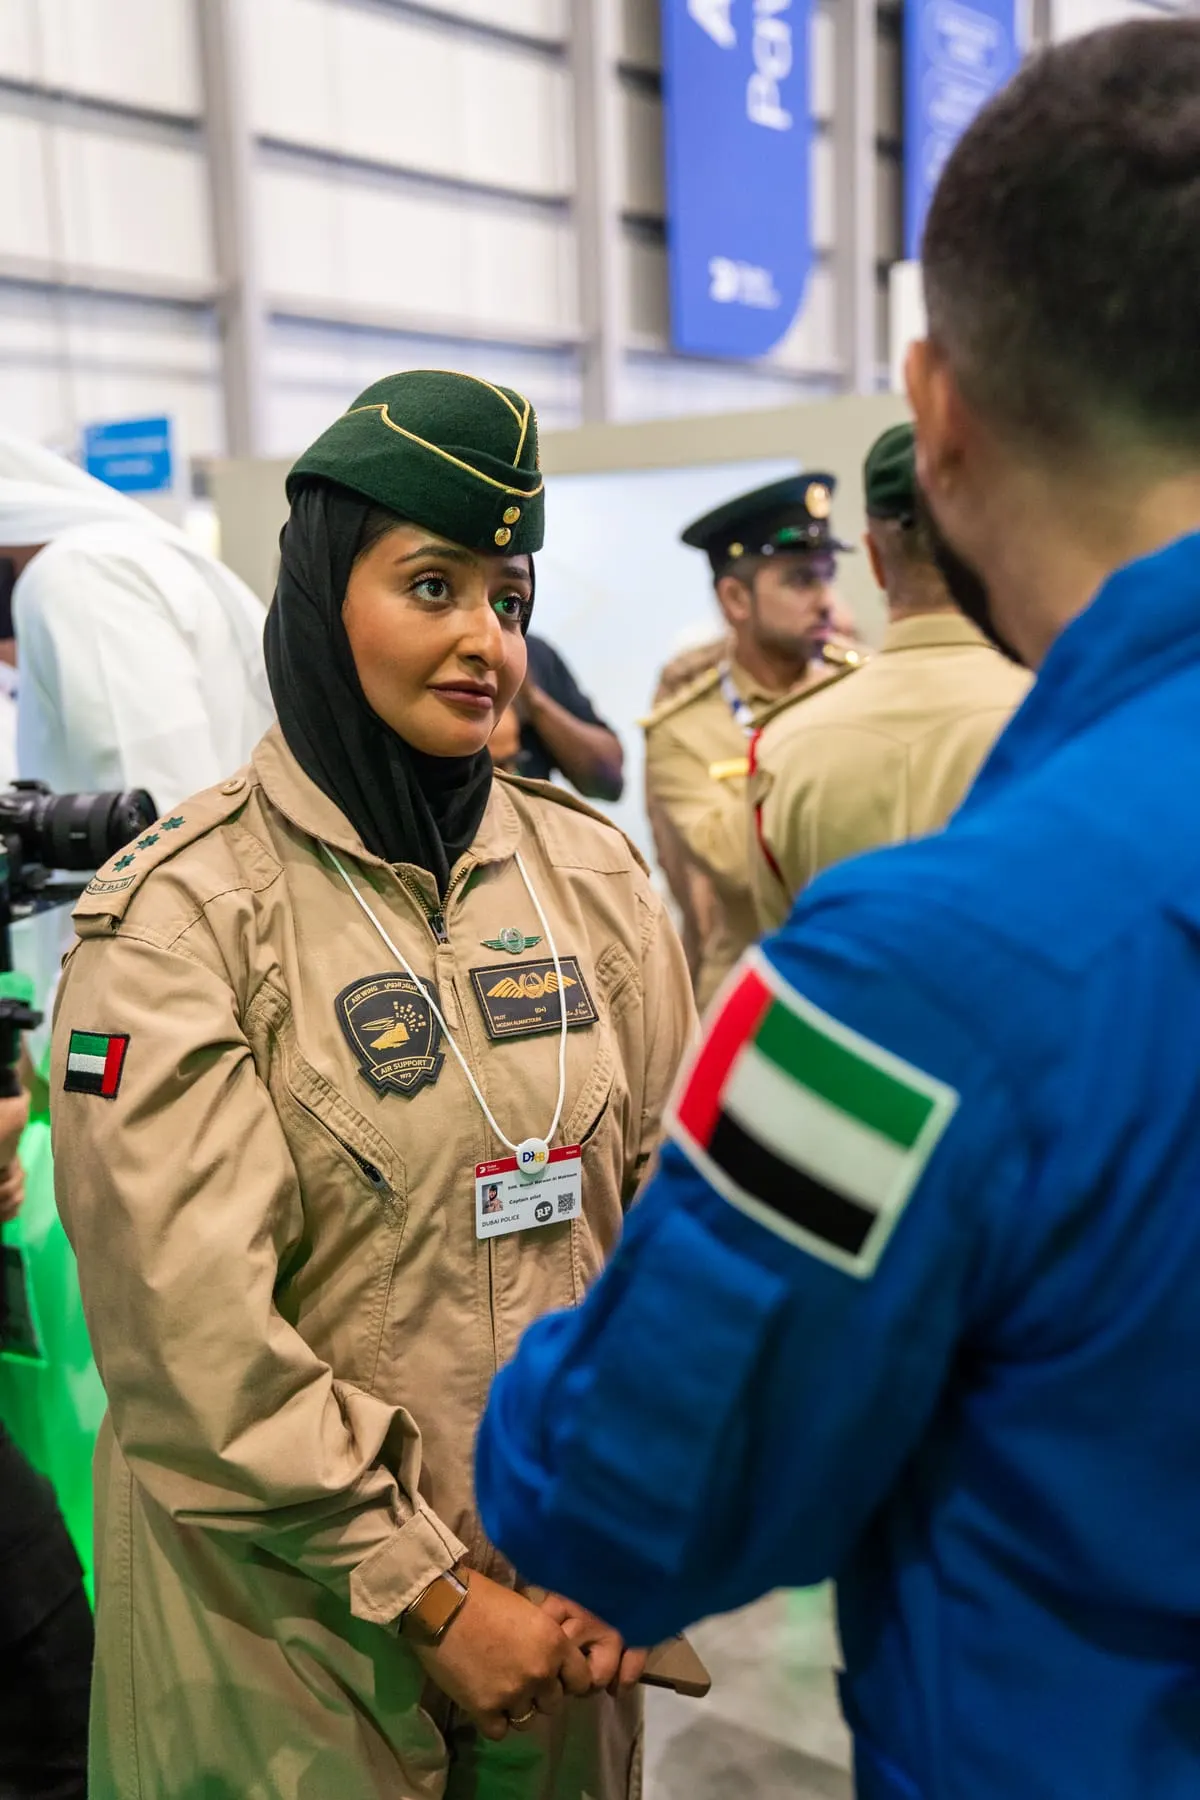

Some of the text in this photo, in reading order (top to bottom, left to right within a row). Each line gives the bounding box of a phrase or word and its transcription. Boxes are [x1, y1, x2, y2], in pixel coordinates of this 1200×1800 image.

[351, 985, 378, 1004] AIR WING
[381, 1059, 427, 1075] AIR SUPPORT
[536, 1205, 551, 1218] RP
[481, 1214, 520, 1227] DUBAI POLICE
